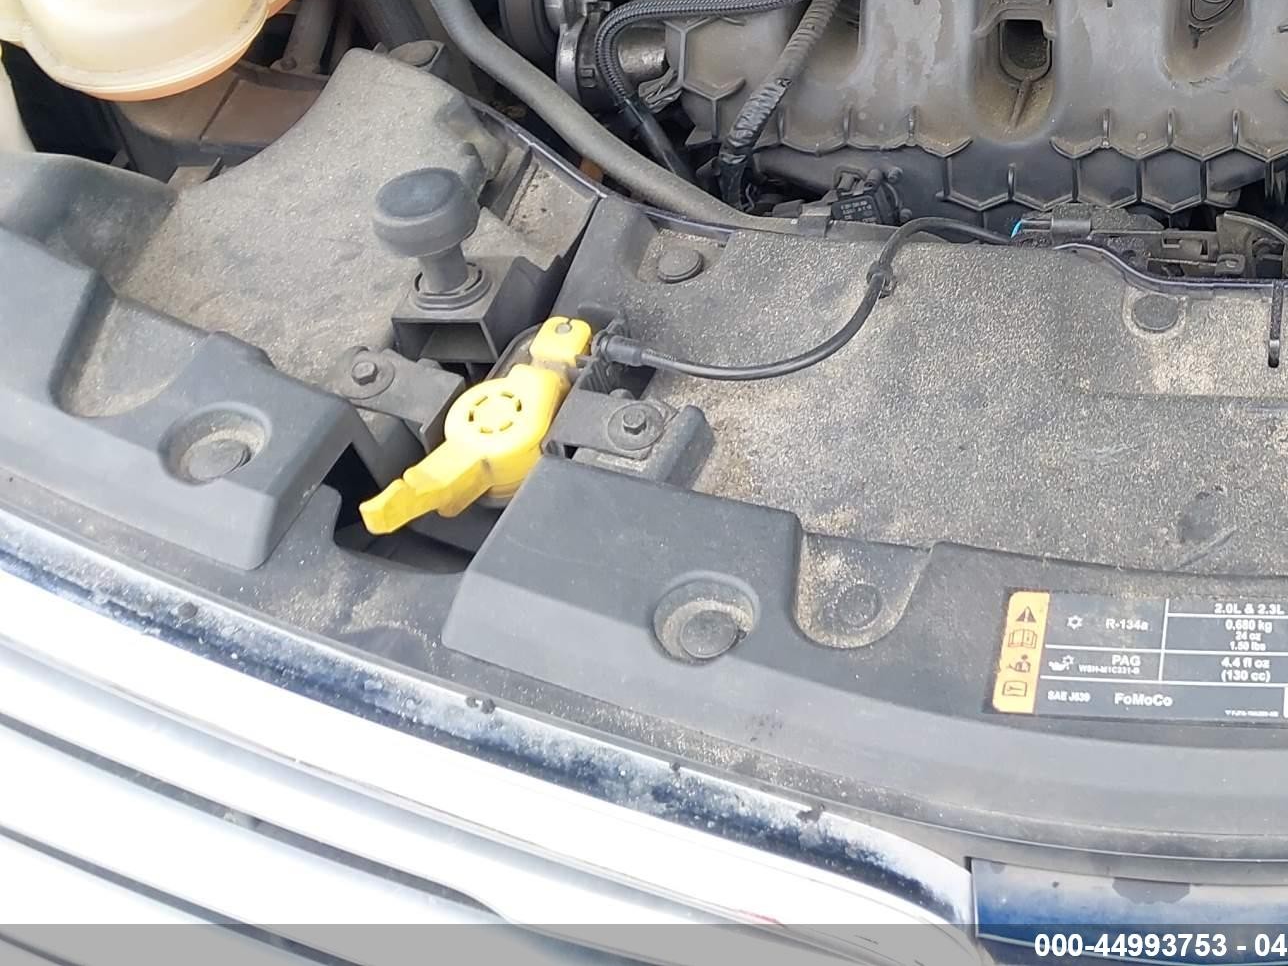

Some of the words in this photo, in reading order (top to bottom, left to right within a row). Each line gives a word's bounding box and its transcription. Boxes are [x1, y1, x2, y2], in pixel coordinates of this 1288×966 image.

[1214, 603, 1242, 614] 2.0L
[1244, 603, 1255, 614] &
[1257, 604, 1285, 615] 2.3L
[1105, 618, 1149, 630] R-134a
[1257, 620, 1273, 634] kg
[1111, 654, 1141, 666] PAG
[1221, 656, 1241, 668] 4.4
[1221, 669, 1249, 683] (130
[1250, 670, 1271, 683] cc)
[1114, 692, 1174, 707] FoMoCo
